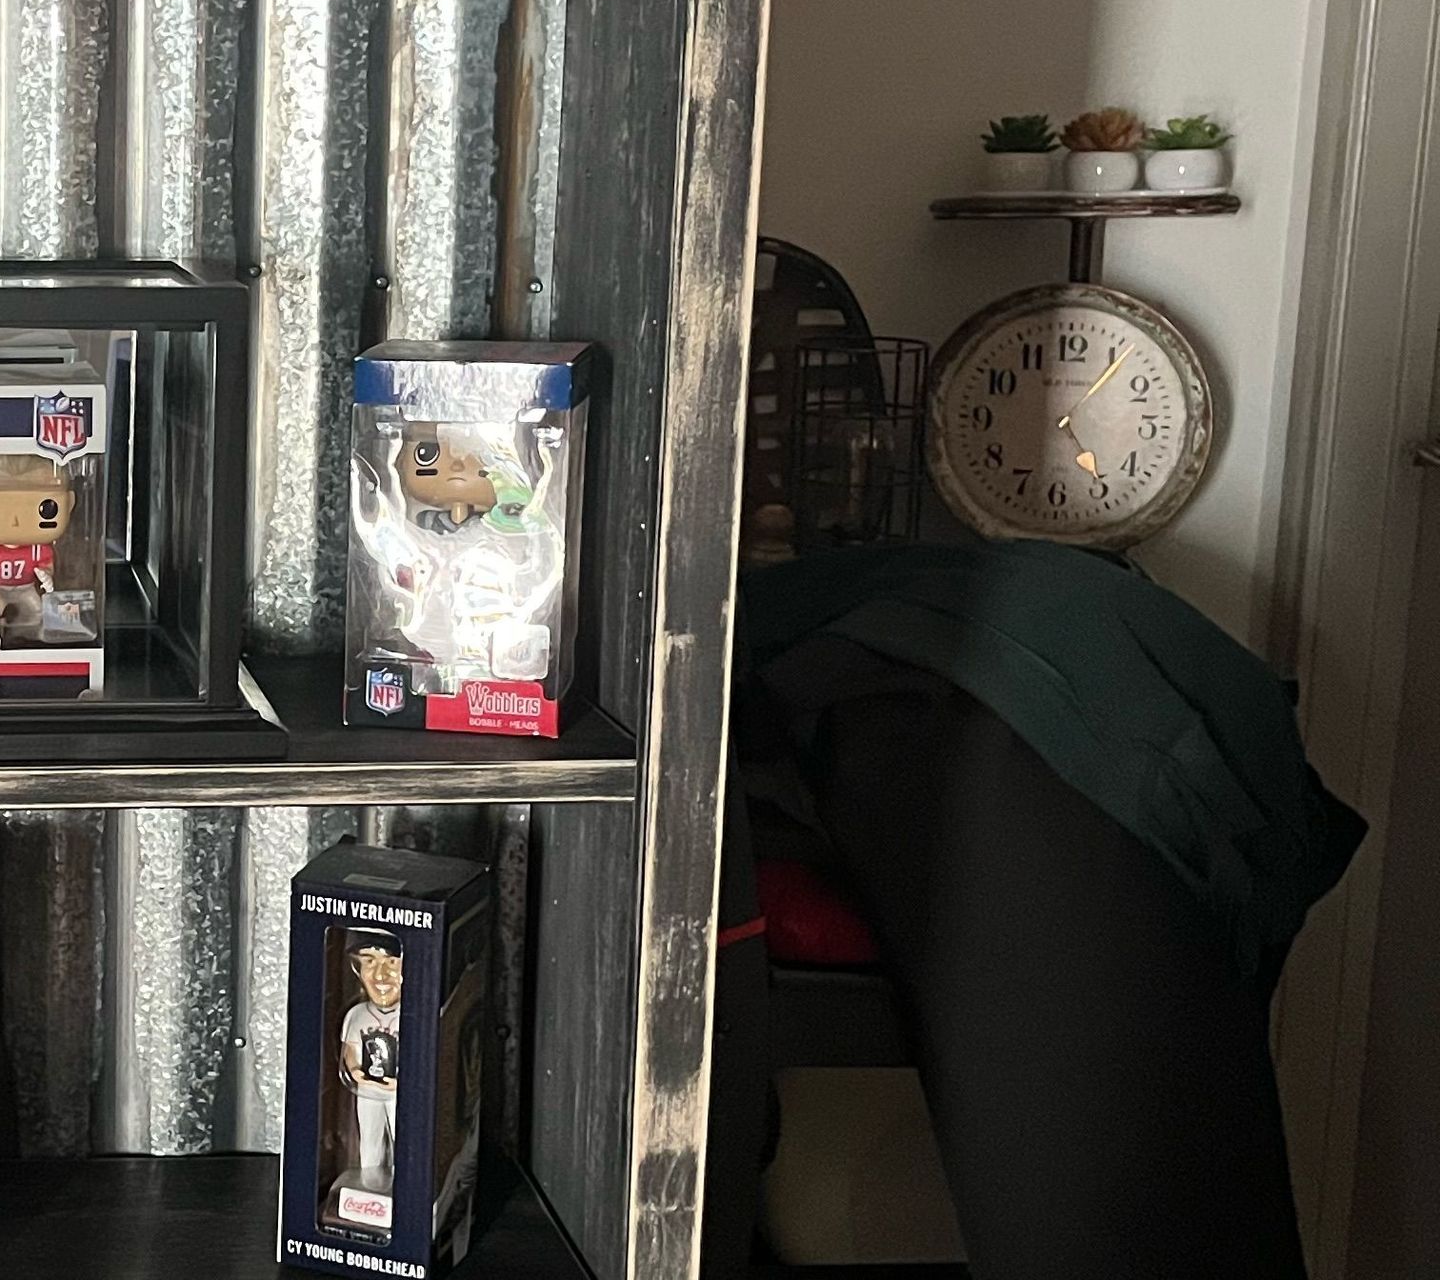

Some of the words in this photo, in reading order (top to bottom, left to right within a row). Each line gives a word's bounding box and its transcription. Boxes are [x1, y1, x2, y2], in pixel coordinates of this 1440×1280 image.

[1022, 344, 1043, 370] 11
[1059, 334, 1089, 363] 12
[988, 369, 1017, 395] 10
[1128, 375, 1150, 403] 2
[42, 415, 85, 448] NFL
[972, 404, 993, 432] 9
[1137, 414, 1159, 440] 3
[986, 442, 1003, 470] 8
[1120, 451, 1137, 477] 4
[1013, 469, 1033, 495] 7
[1048, 480, 1066, 507] 6
[1089, 473, 1108, 500] 5
[0, 560, 26, 580] 87
[373, 685, 403, 708] NFL
[466, 682, 541, 716] Wobblers
[300, 894, 347, 917] JUSTIN
[351, 900, 434, 930] VERLANDER
[286, 1239, 303, 1255] CY
[305, 1243, 344, 1263] YOUNG
[346, 1250, 426, 1280] BOBBLEHEAD
